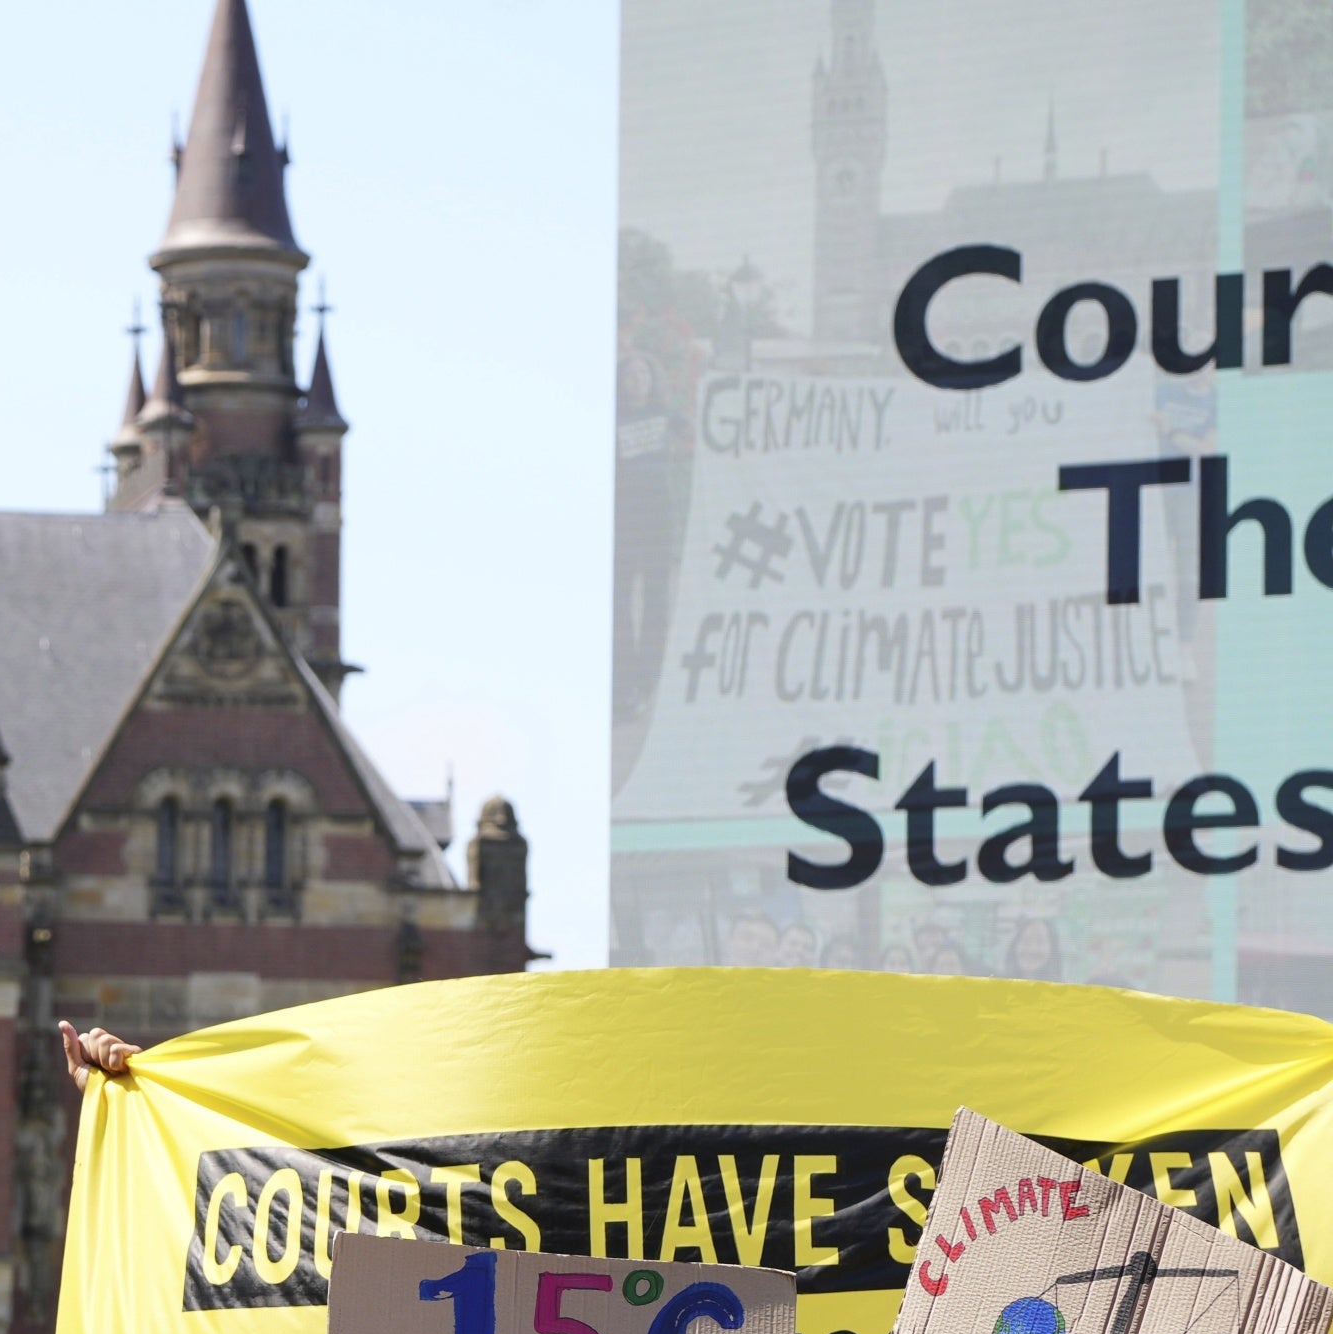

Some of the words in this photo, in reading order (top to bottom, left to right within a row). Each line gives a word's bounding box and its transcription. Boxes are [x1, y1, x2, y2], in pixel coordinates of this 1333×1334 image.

[203, 1159, 541, 1286] COURTS
[588, 1154, 840, 1267] HAVE
[918, 1176, 1090, 1297] CLIMATE
